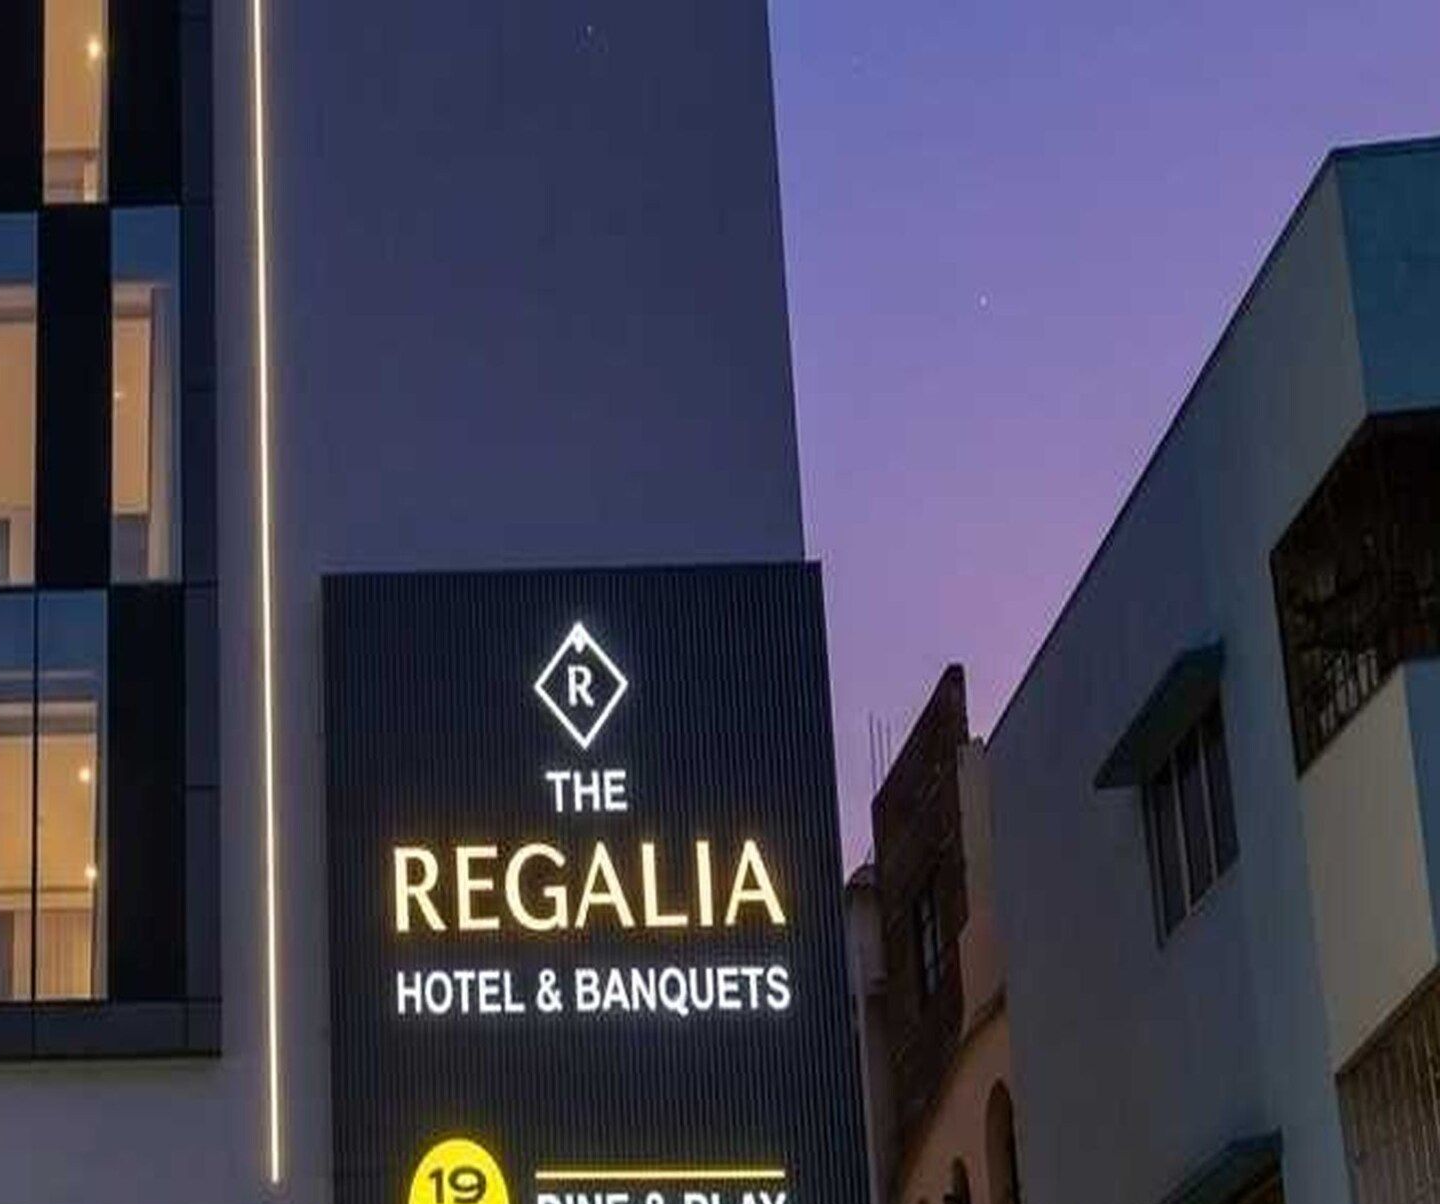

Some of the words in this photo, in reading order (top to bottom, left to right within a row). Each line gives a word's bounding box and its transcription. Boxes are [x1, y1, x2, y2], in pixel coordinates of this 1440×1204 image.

[567, 664, 595, 708] R
[545, 768, 628, 813] THE
[393, 840, 786, 932] REGALIA
[397, 970, 525, 1015] HOTEL
[536, 968, 562, 1012] &
[577, 966, 791, 1016] BANQUETS
